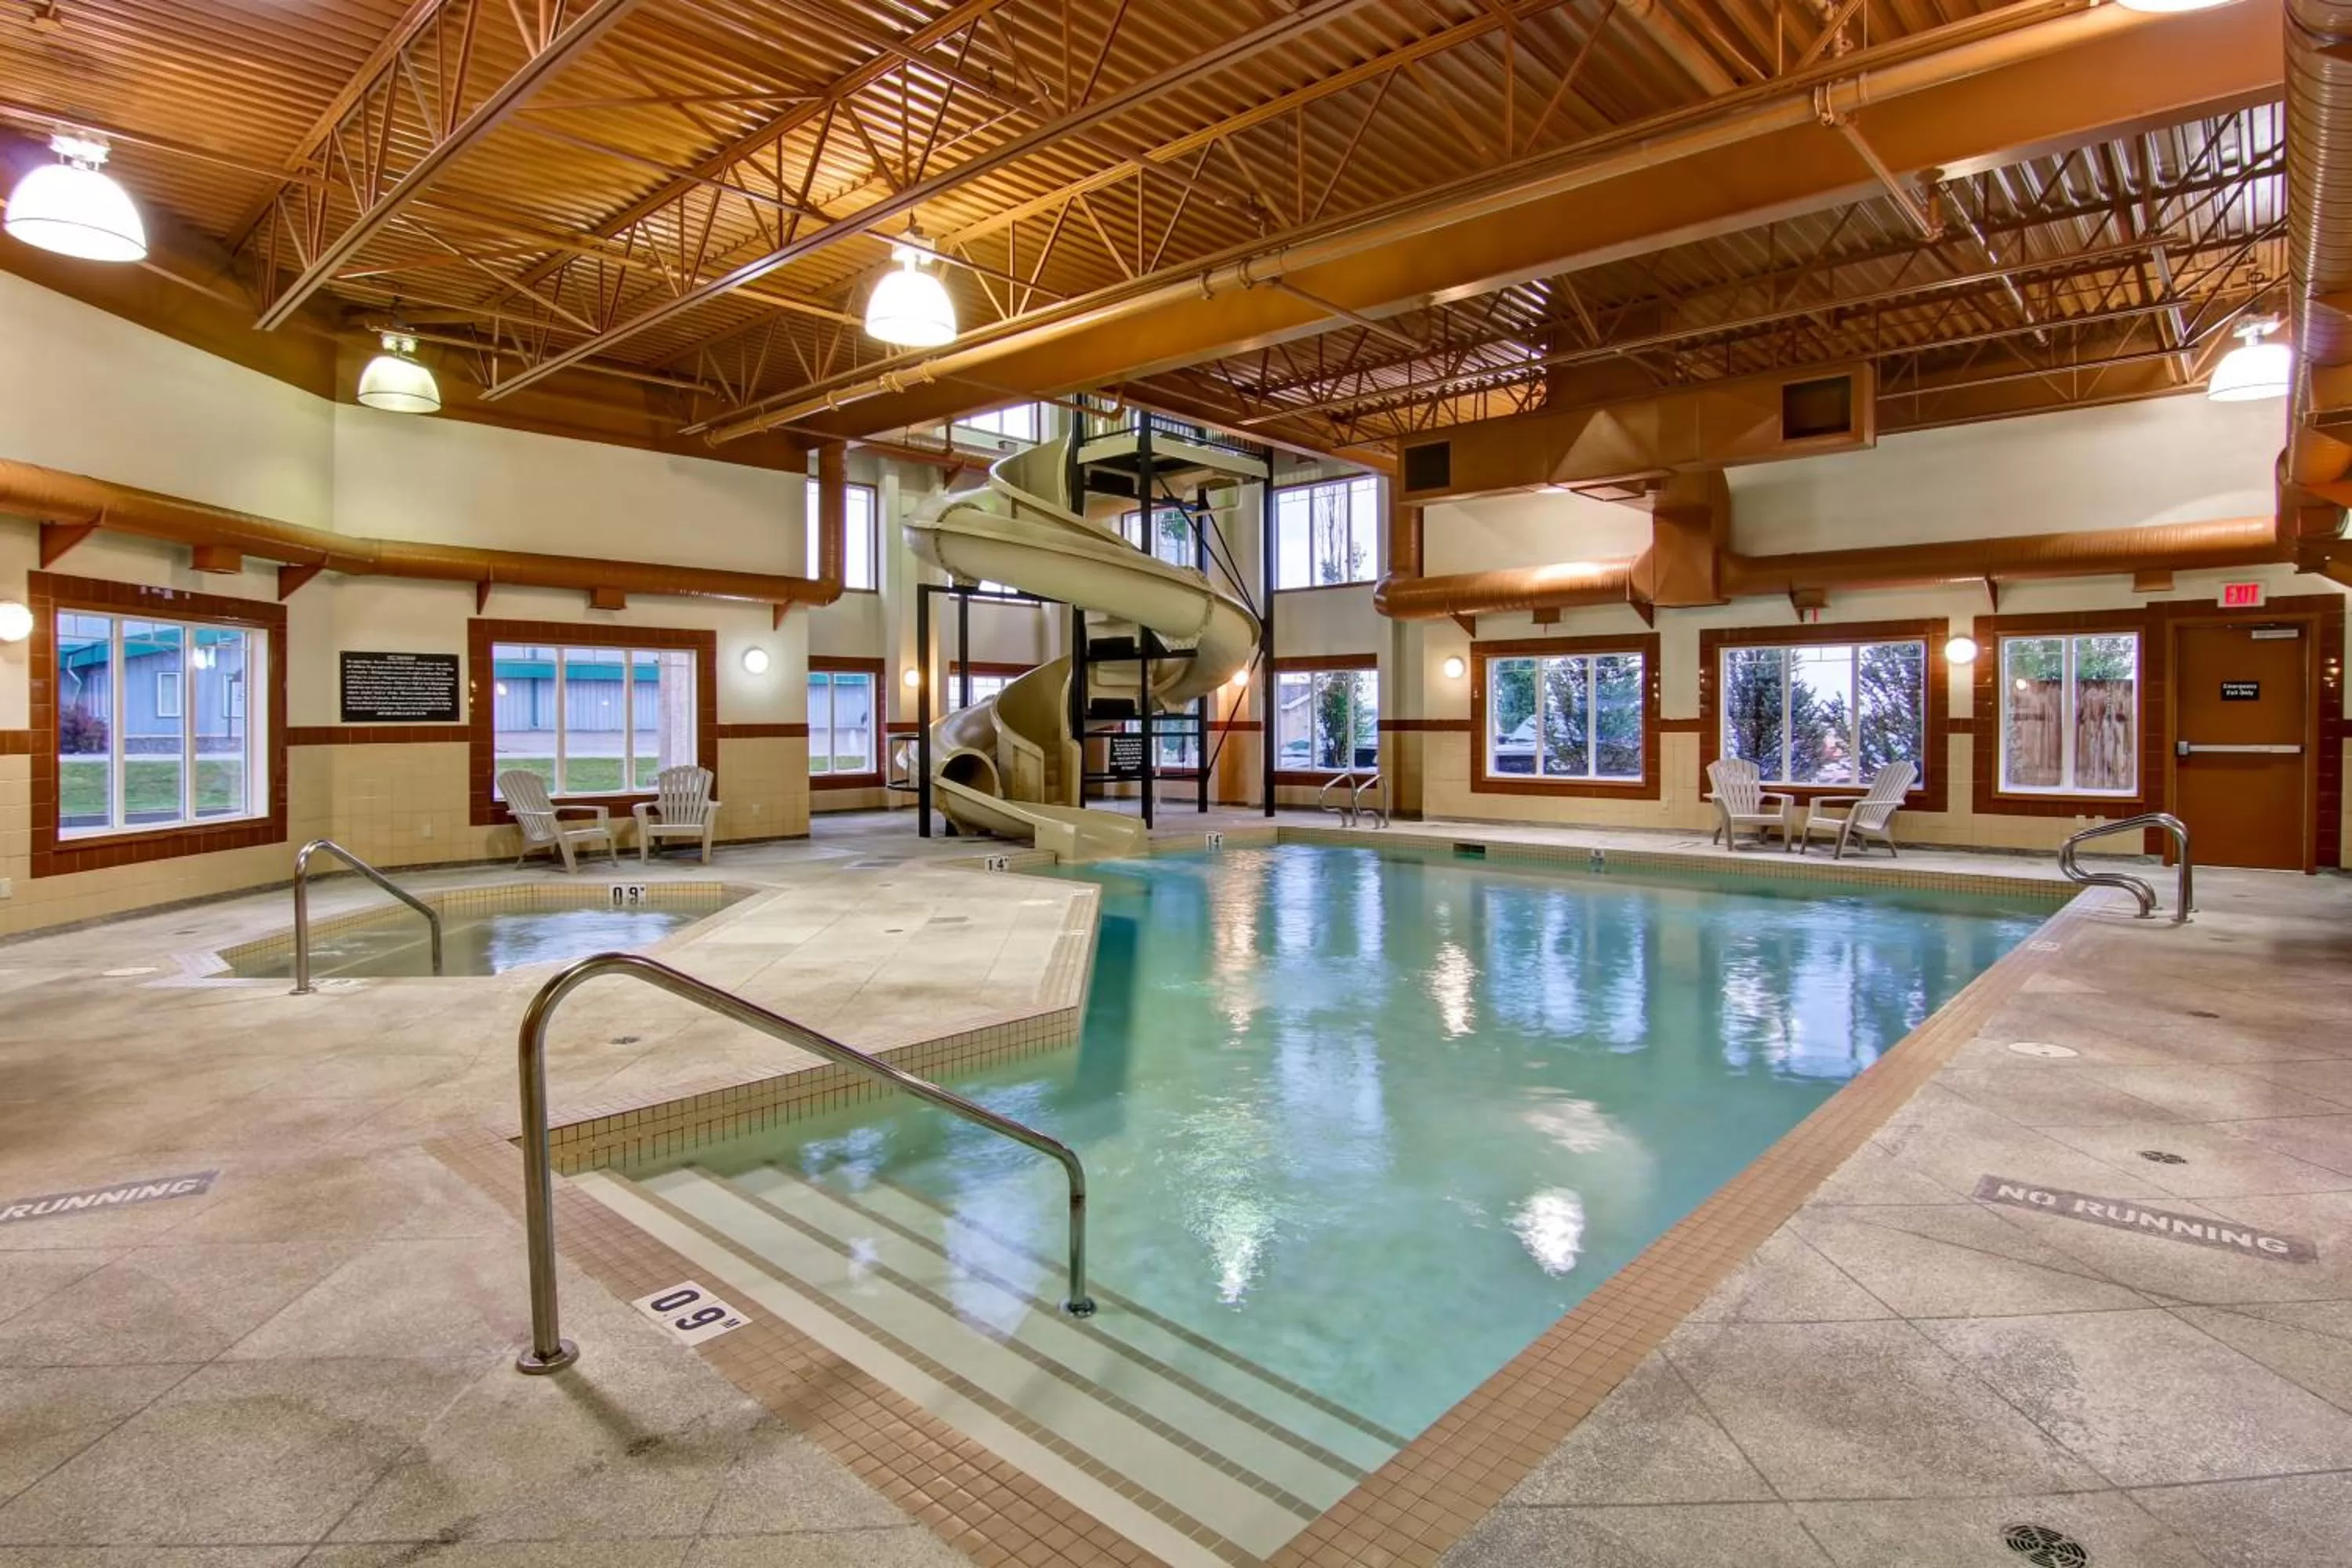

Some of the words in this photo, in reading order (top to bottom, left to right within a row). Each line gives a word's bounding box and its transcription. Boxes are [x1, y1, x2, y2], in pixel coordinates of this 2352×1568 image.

[2225, 584, 2259, 604] EXIT
[0, 1179, 200, 1221] RUNNING
[1998, 1185, 2057, 1206] NO
[2074, 1199, 2289, 1254] RUNNING
